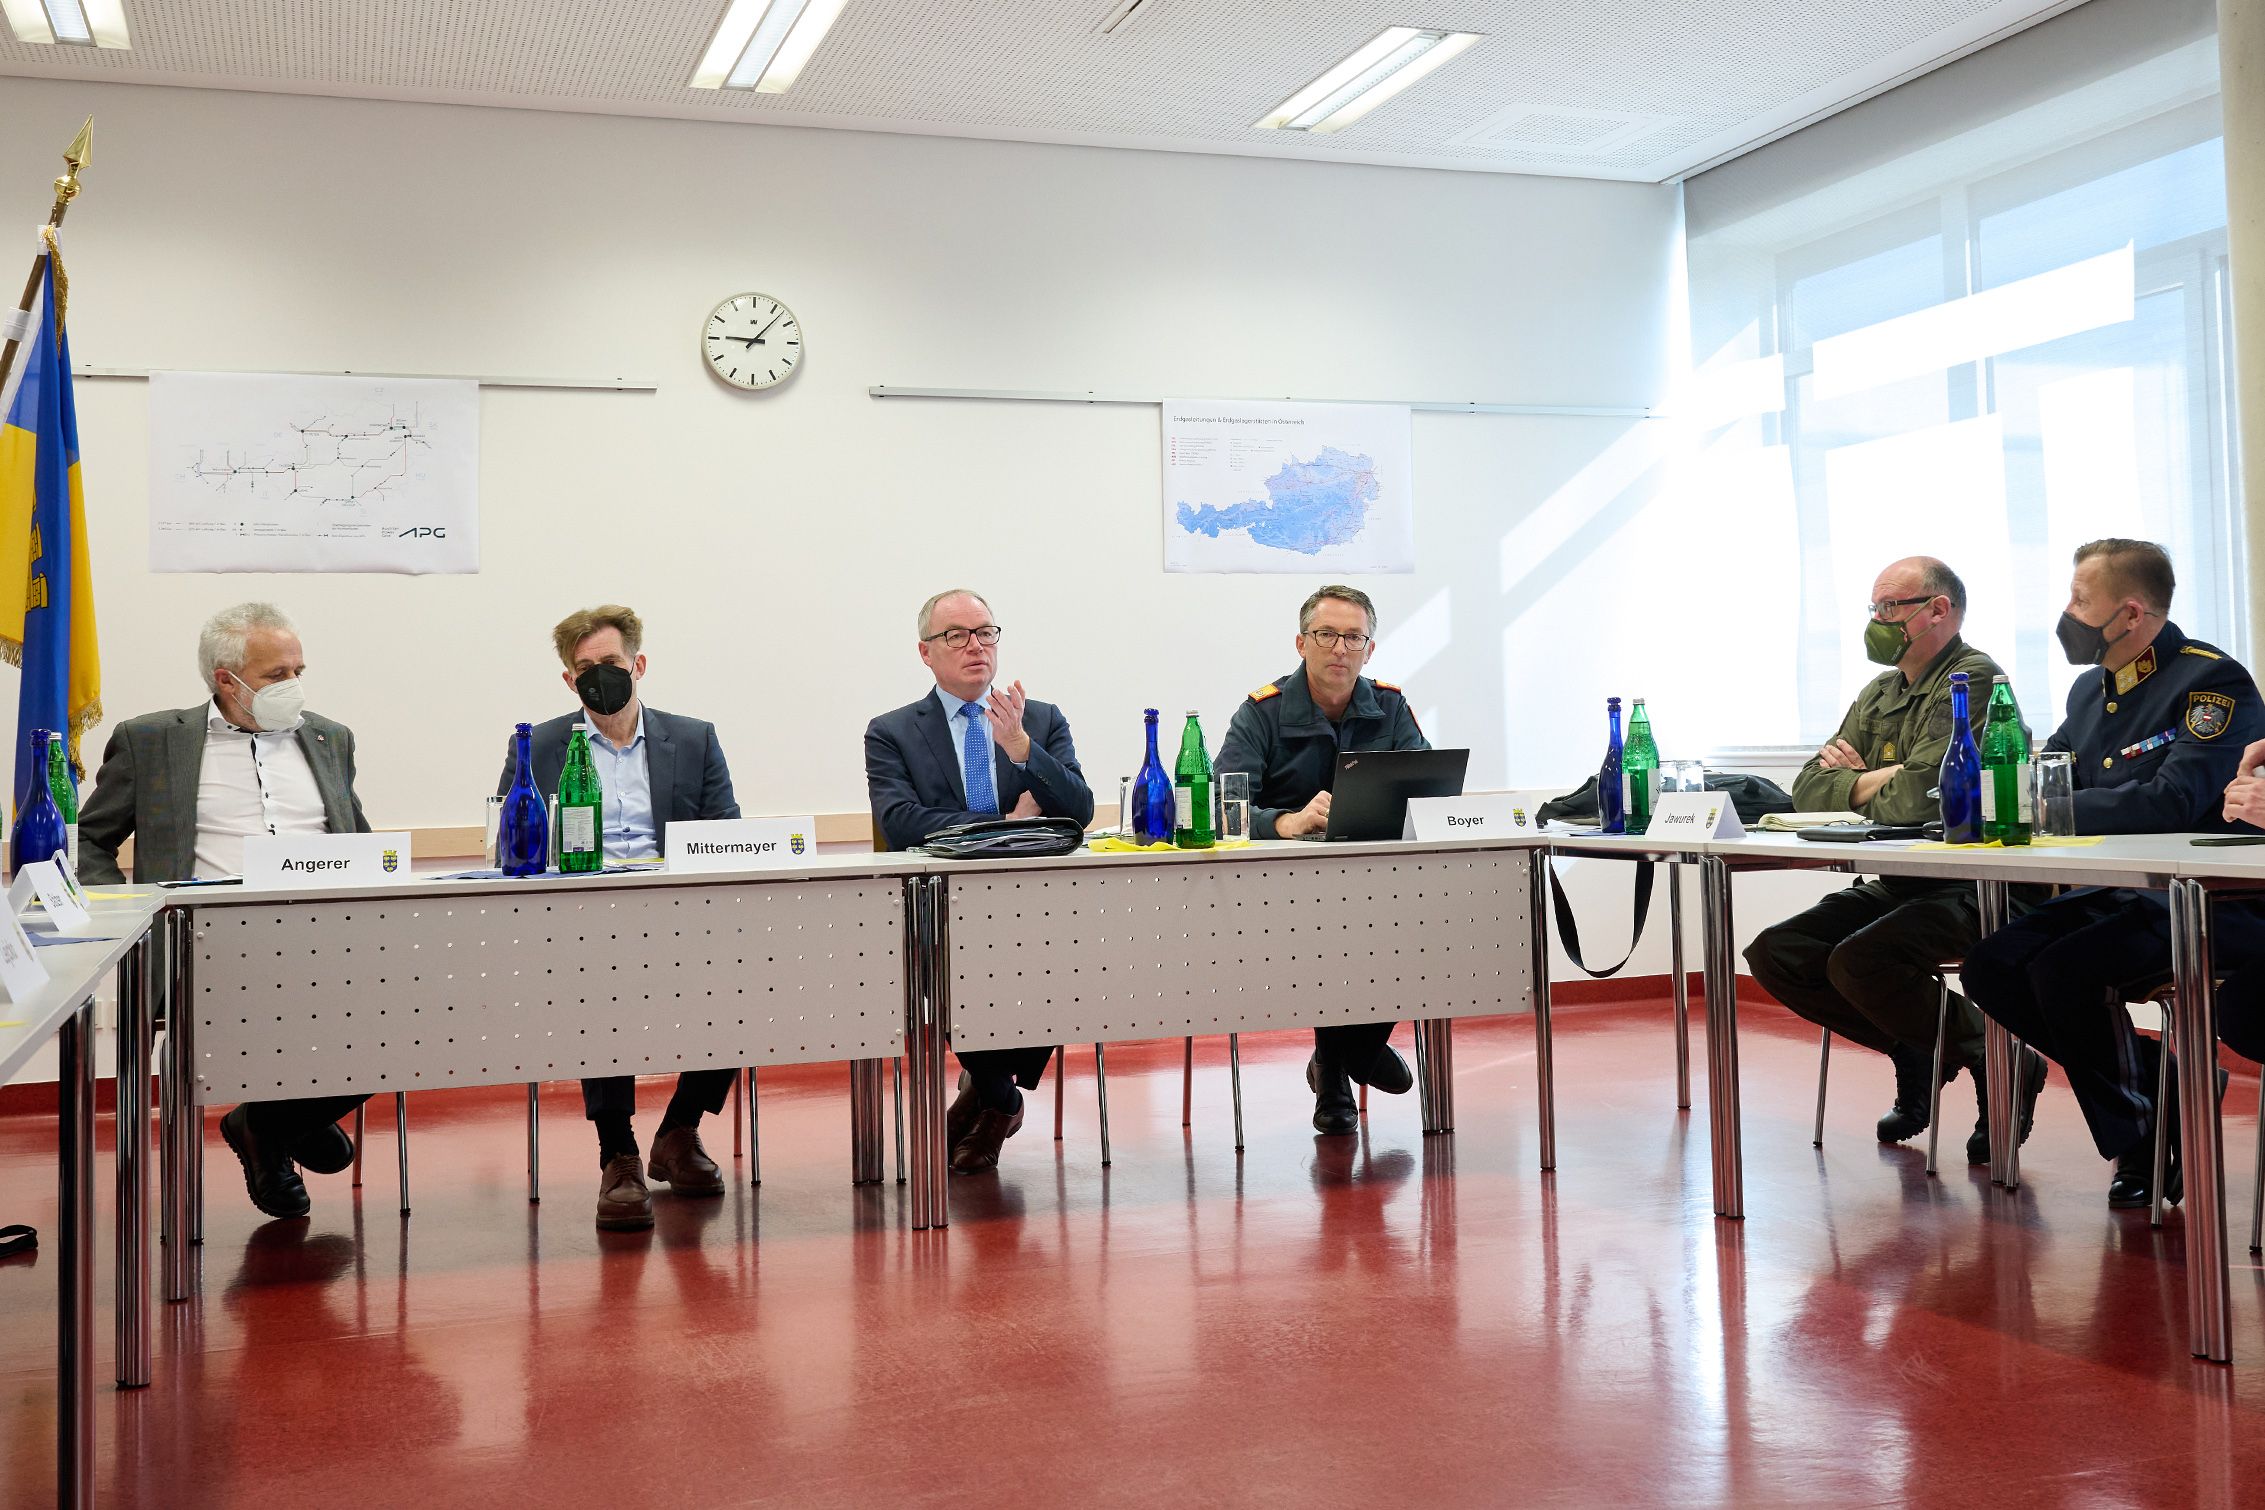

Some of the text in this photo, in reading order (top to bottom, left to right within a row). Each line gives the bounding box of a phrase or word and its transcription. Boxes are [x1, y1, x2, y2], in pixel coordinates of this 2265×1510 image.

[399, 527, 446, 538] APG
[2193, 694, 2231, 708] POLIZEI
[1447, 815, 1485, 828] Boyer
[1664, 812, 1696, 824] Jawurek
[686, 841, 777, 855] Mittermayer
[281, 858, 351, 873] Angerer
